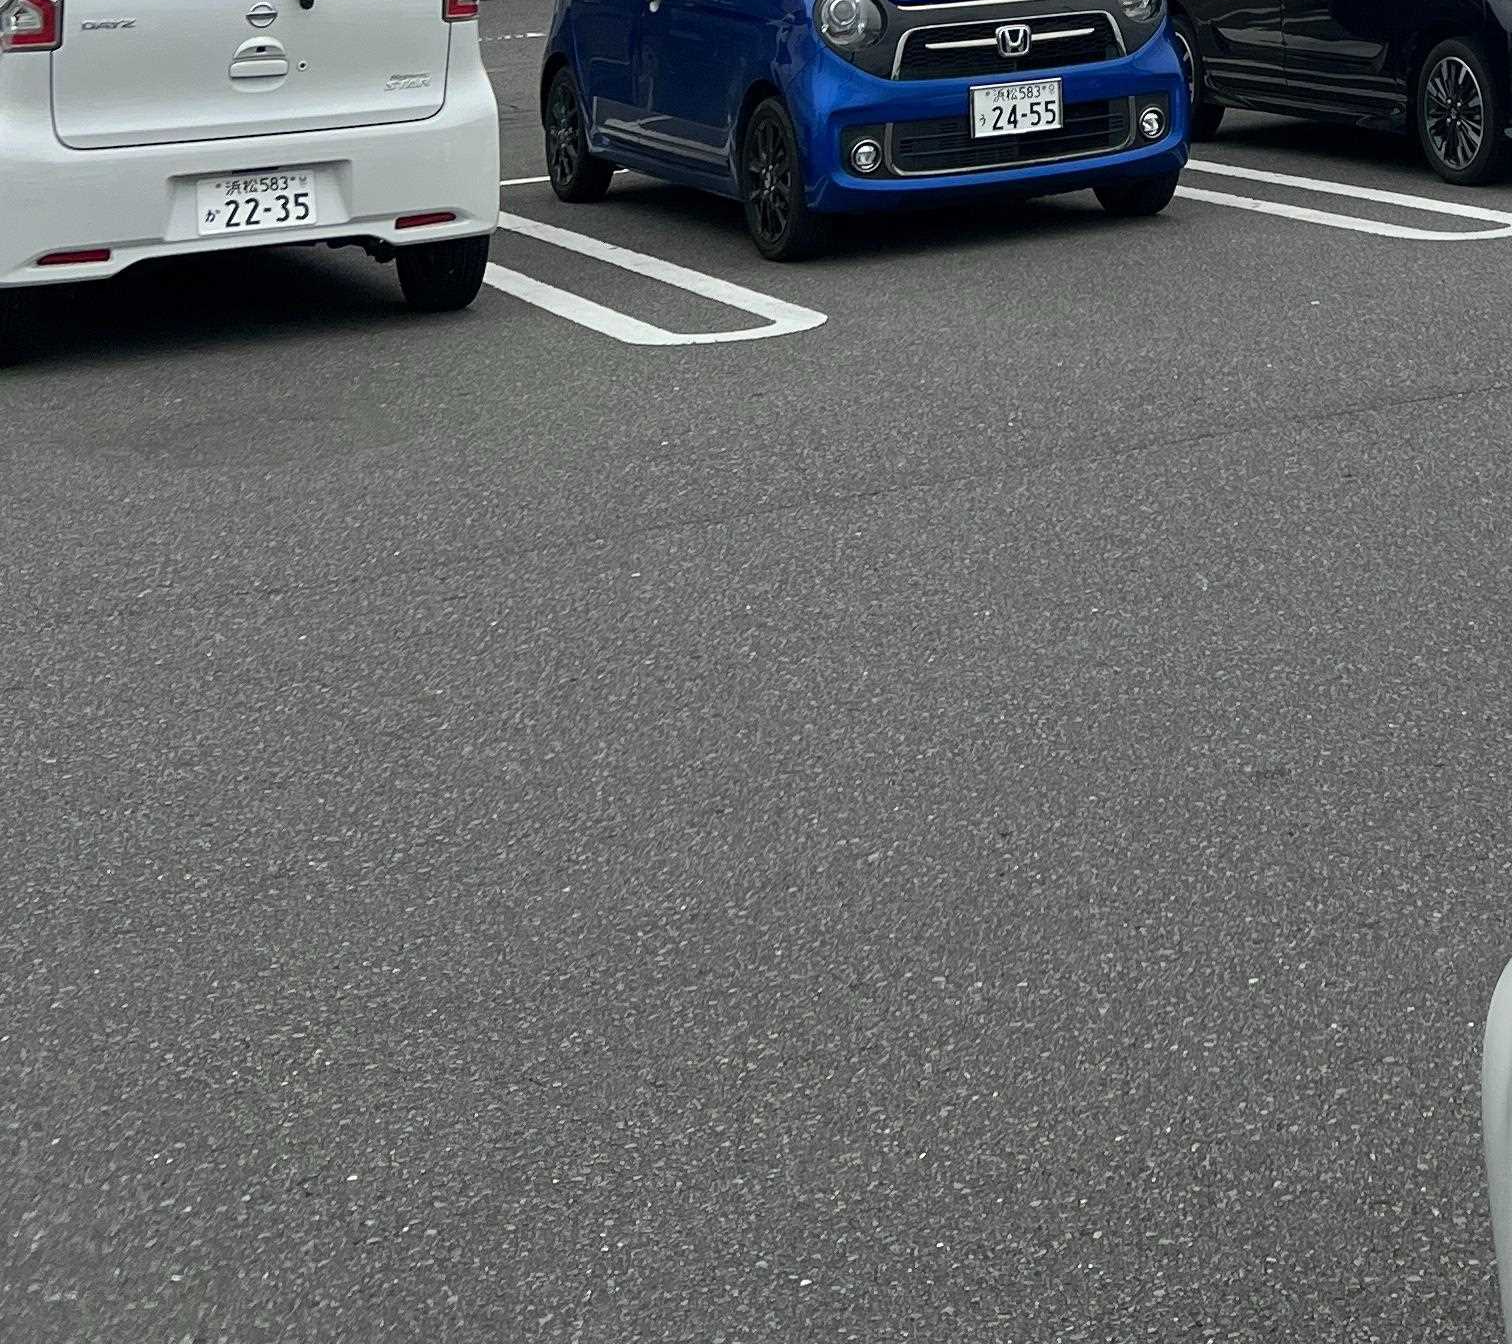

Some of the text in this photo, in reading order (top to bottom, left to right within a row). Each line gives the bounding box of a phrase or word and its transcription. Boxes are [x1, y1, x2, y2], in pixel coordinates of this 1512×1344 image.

[992, 100, 1056, 131] 24-55
[225, 175, 289, 196] 浜松583
[224, 192, 310, 228] 22-35
